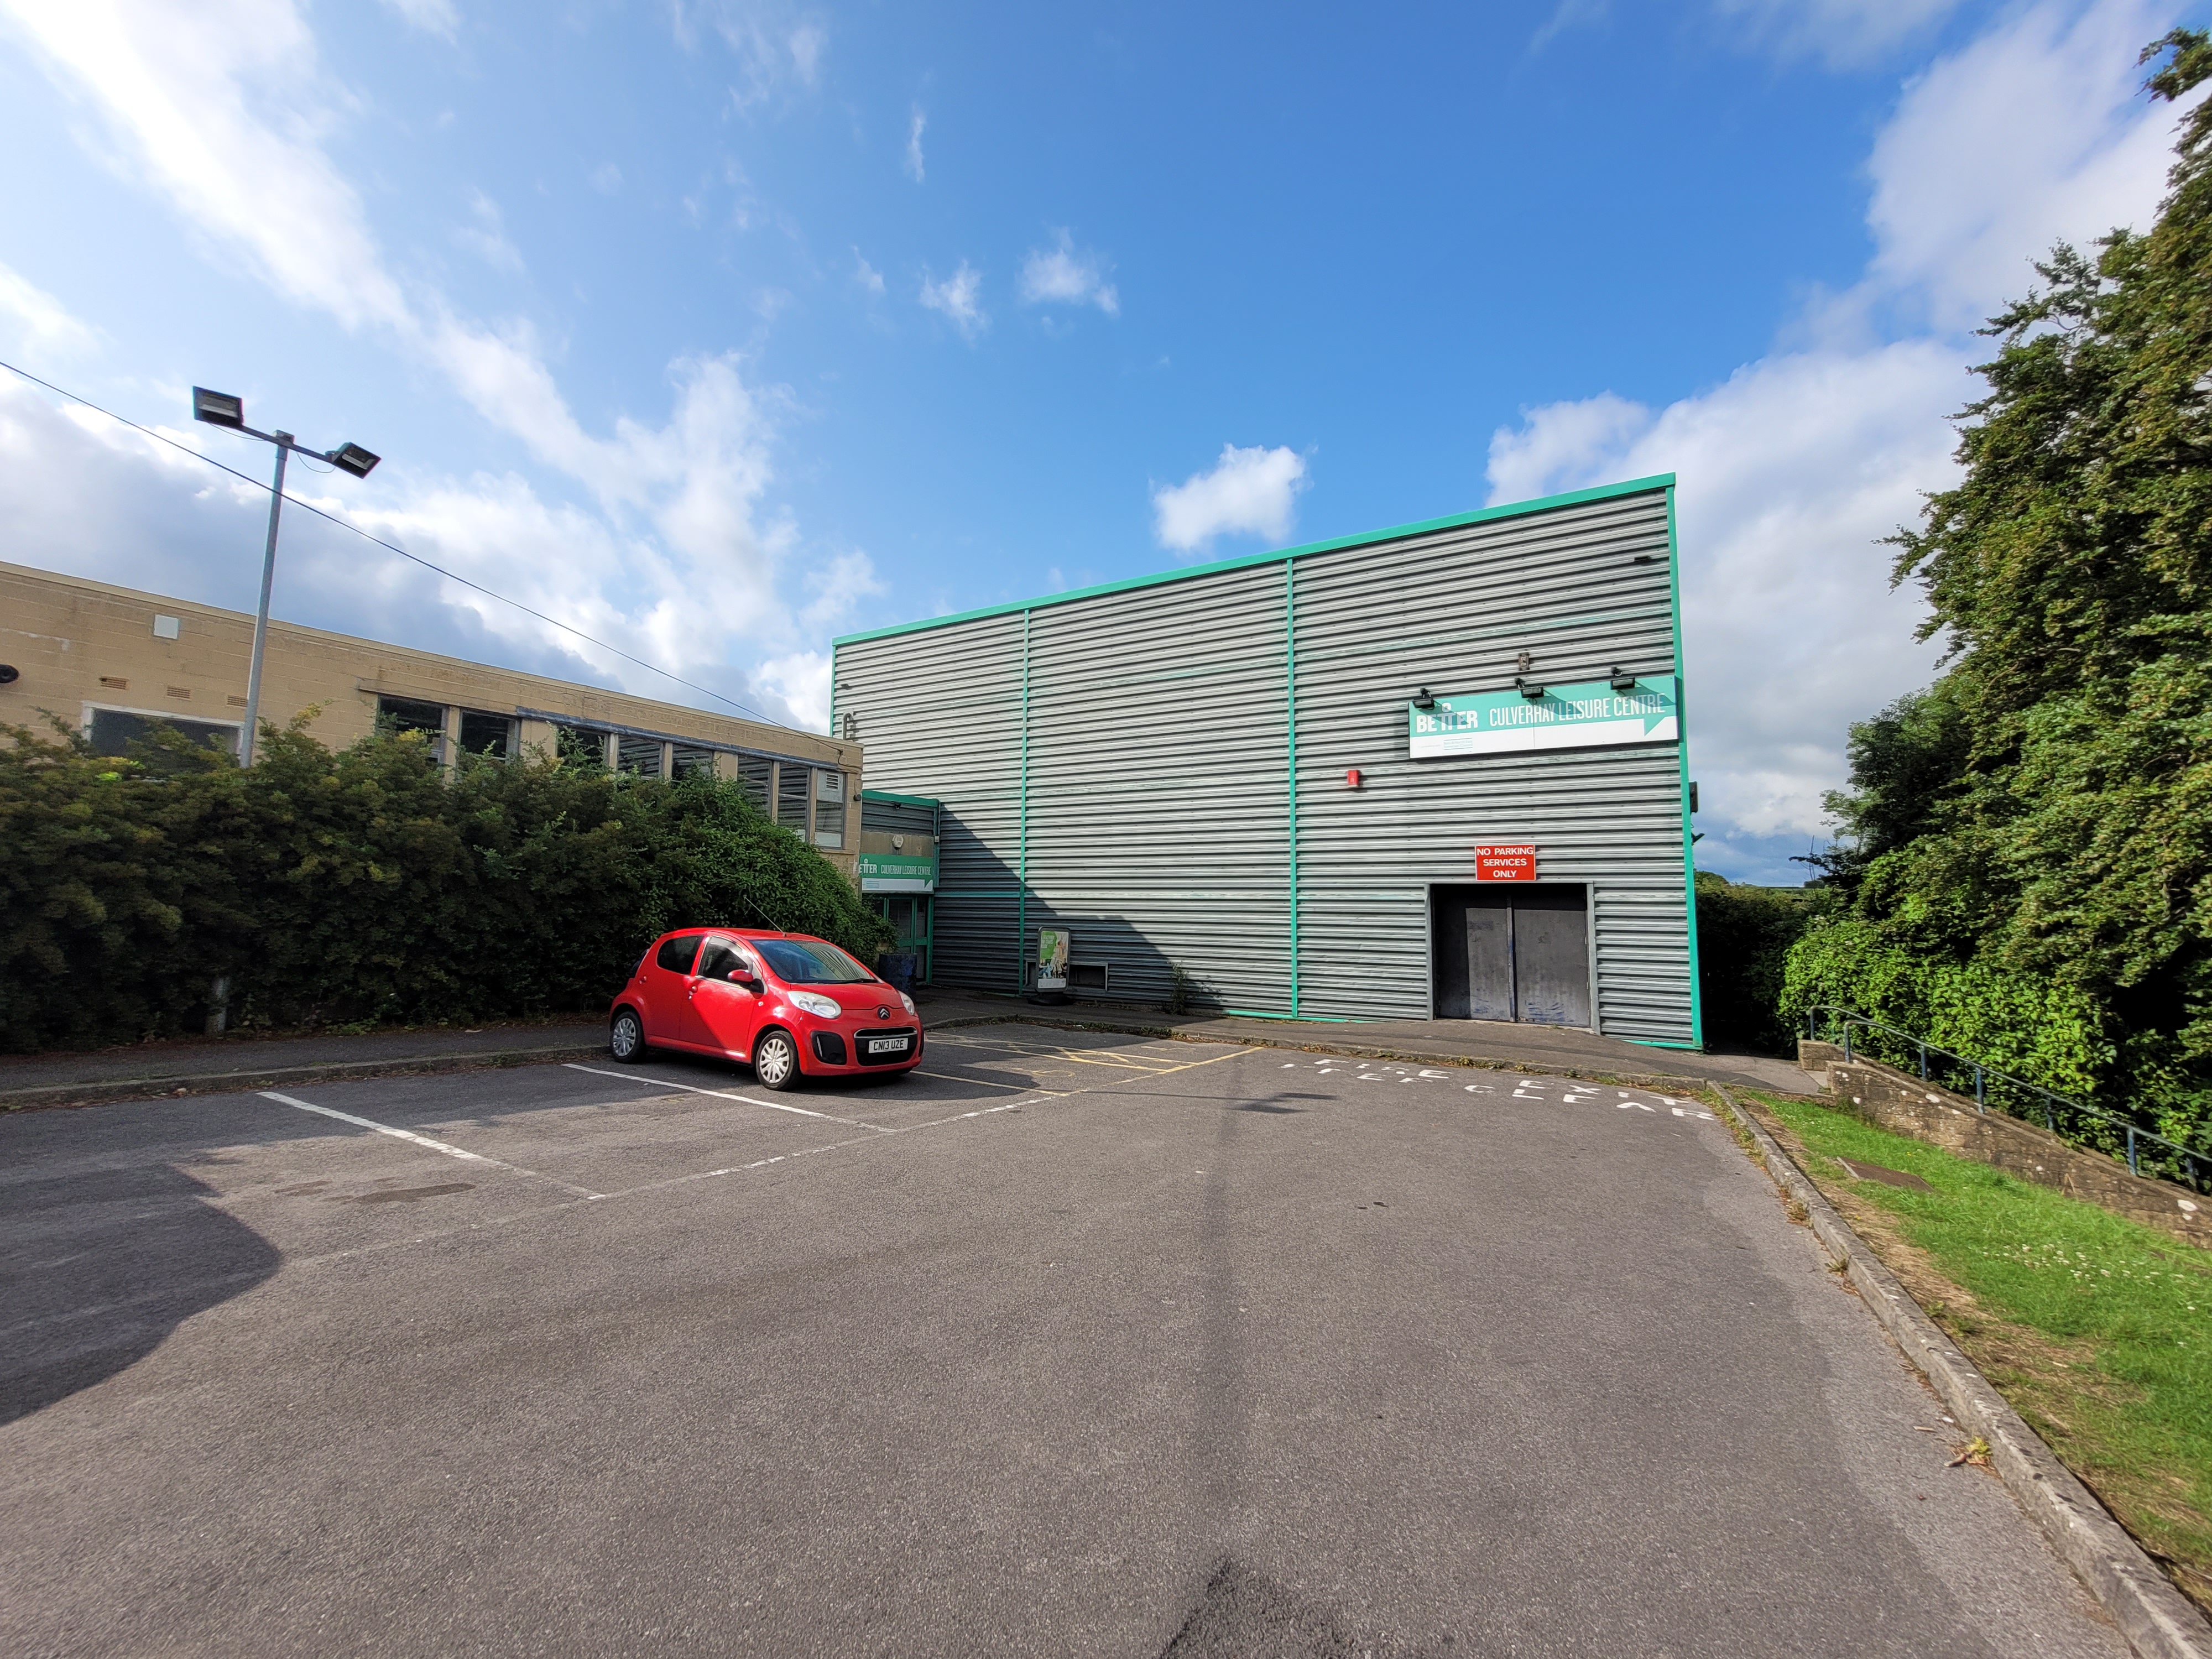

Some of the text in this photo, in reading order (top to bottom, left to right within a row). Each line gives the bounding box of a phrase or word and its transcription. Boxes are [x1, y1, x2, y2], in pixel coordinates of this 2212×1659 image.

[1416, 693, 1666, 733] BETTER CULVERHAY LEISURE CENTRE
[1494, 847, 1534, 855] PARKING
[858, 860, 931, 875] ETTER CULVERHAY LEISURE CENTRE
[874, 1040, 904, 1051] CN13 UZE
